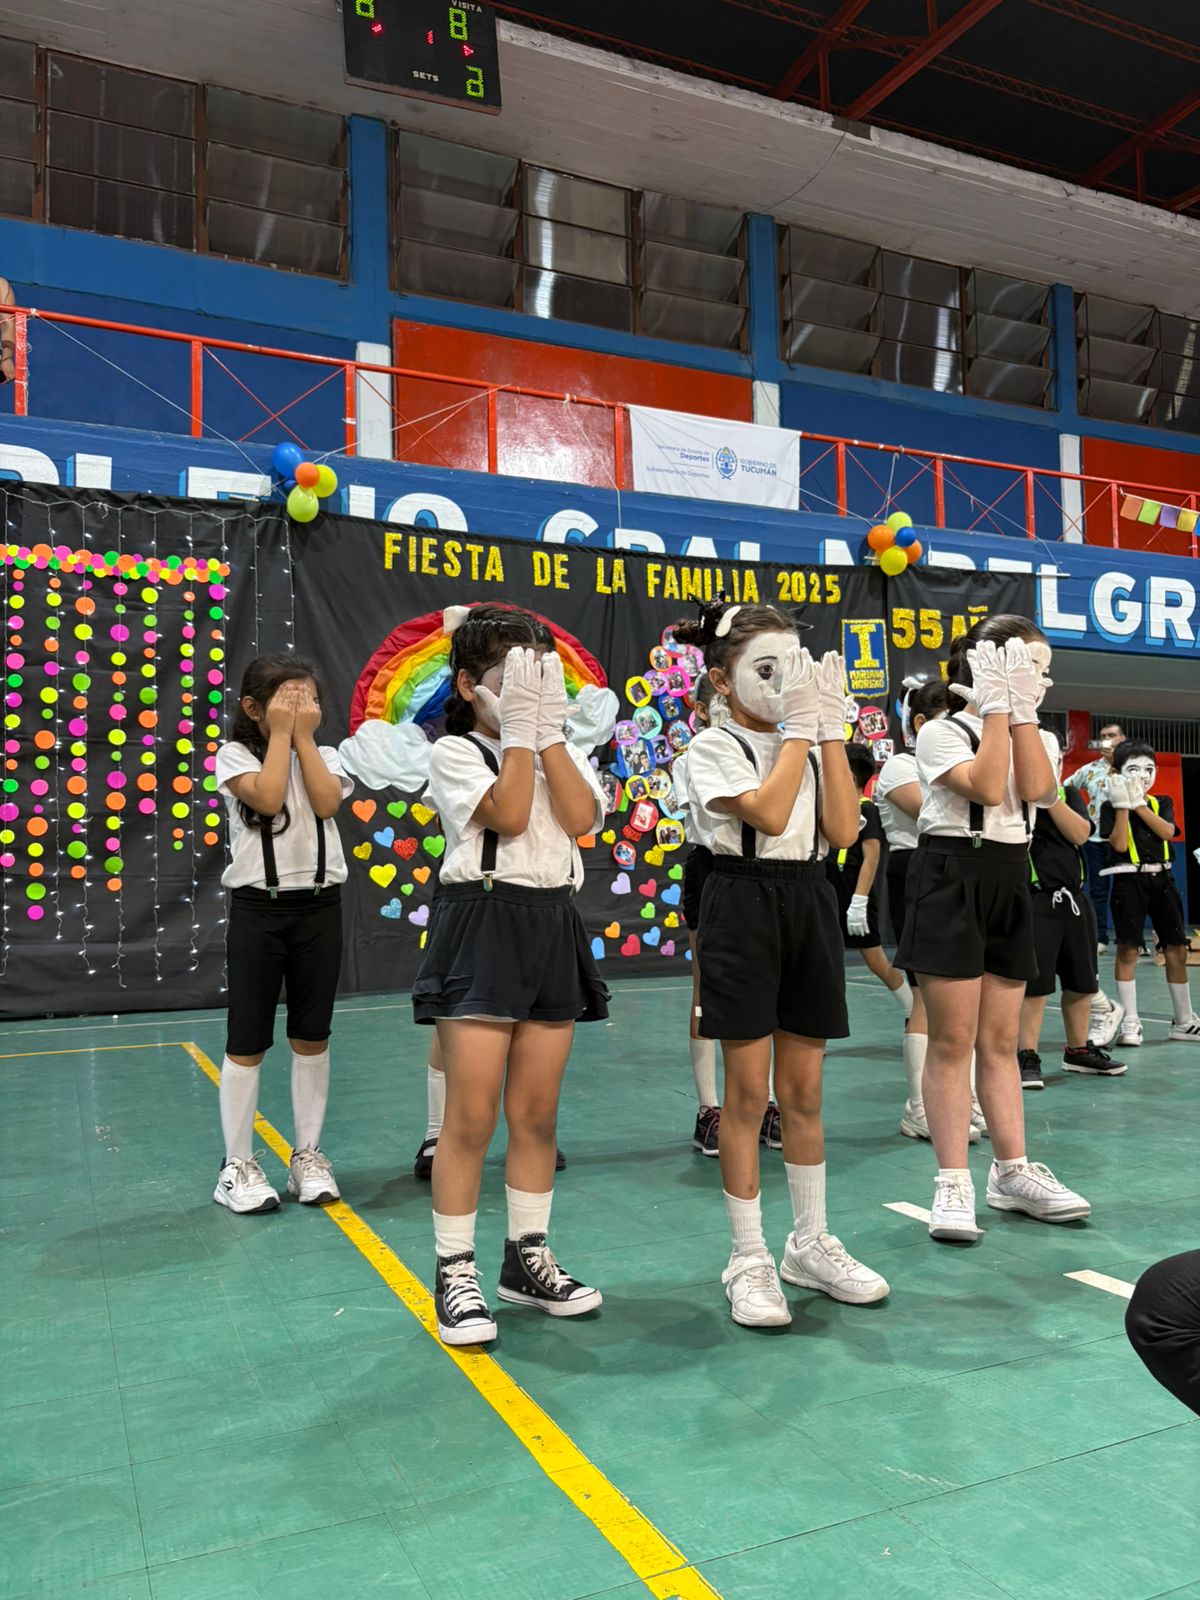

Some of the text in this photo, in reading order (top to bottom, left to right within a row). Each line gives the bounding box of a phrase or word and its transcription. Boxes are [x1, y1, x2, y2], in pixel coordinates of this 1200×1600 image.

[451, 0, 483, 13] VISITA
[449, 7, 467, 41] 8
[412, 70, 439, 82] SETS
[680, 452, 710, 463] Deportes
[384, 532, 504, 582] FIESTA
[532, 551, 570, 589] DE
[596, 557, 627, 595] LA
[647, 563, 760, 603] FAMILIA
[777, 571, 841, 605] 2025
[891, 607, 944, 649] 55
